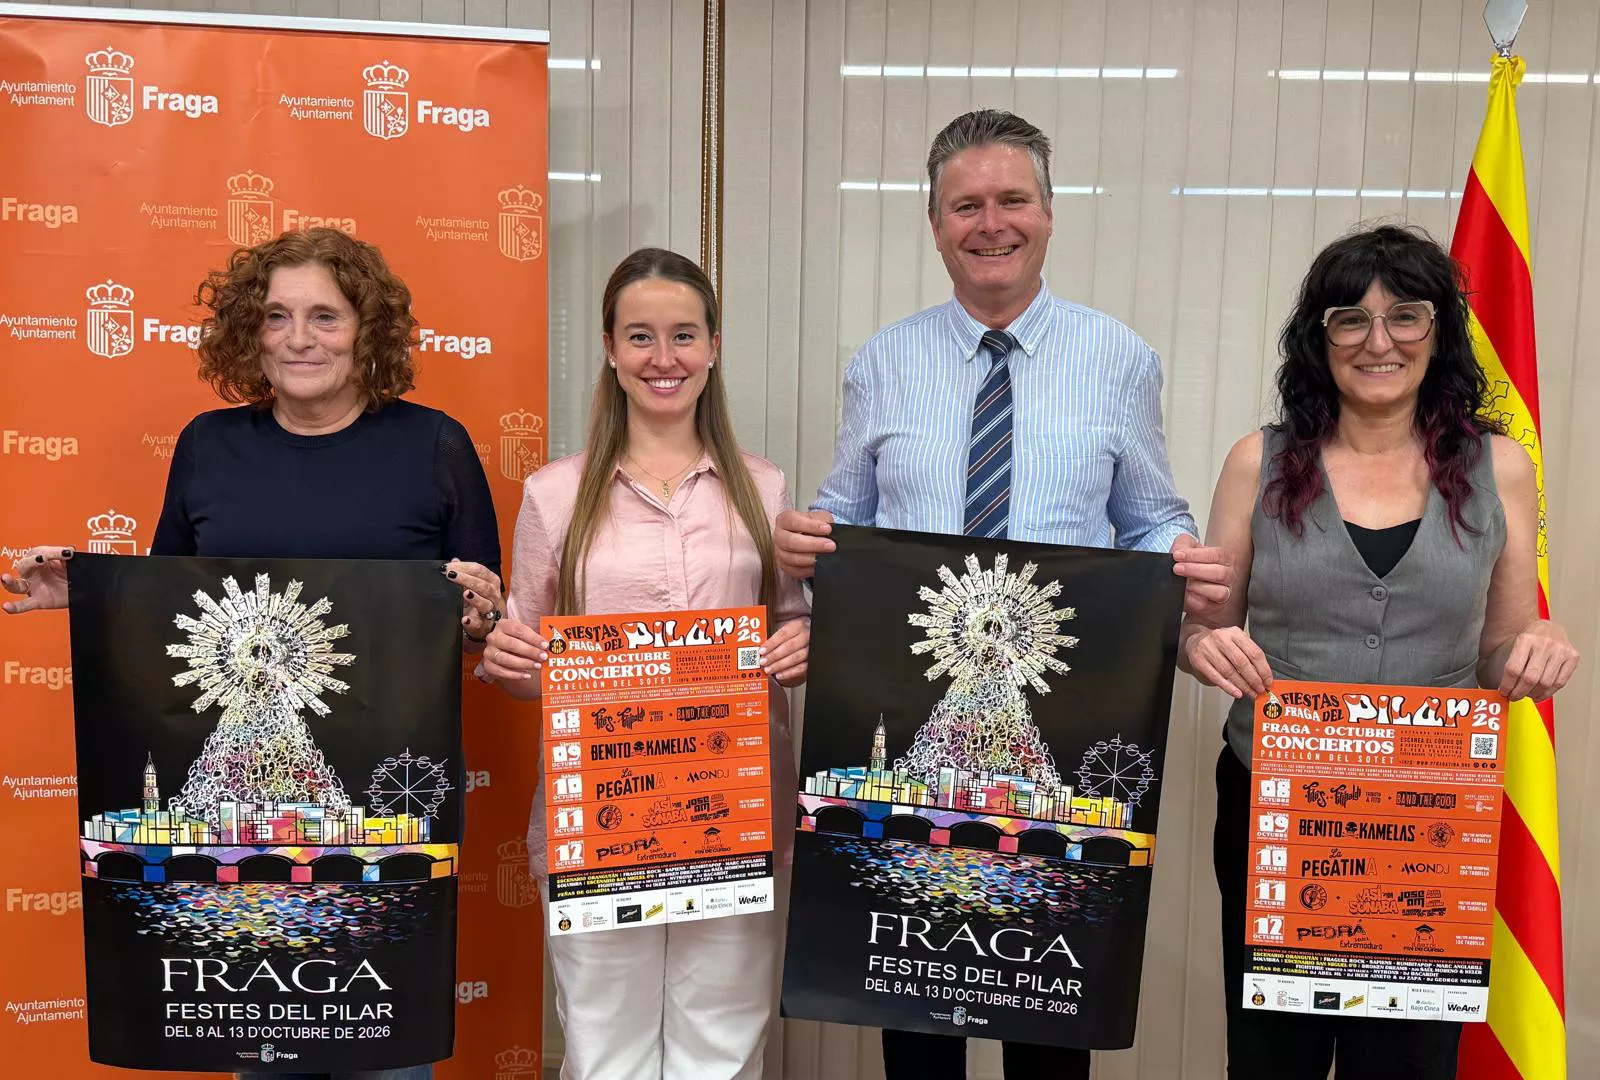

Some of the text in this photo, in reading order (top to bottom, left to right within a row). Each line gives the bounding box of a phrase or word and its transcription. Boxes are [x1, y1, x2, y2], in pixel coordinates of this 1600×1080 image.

[0, 80, 76, 94] Ayuntamiento
[11, 93, 75, 107] Ajuntament
[143, 86, 218, 119] Fraga
[280, 94, 354, 108] Ayuntamiento
[290, 108, 353, 121] Ajuntament
[418, 100, 489, 132] Fraga
[2, 197, 78, 228] Fraga
[140, 202, 218, 217] Ayuntamiento
[151, 216, 216, 230] Ajuntament
[416, 216, 490, 230] Ayuntamiento
[426, 228, 488, 242] Ajuntament
[0, 314, 77, 328] Ayuntamiento
[10, 326, 76, 340] Ajuntament
[143, 318, 203, 350] Frag
[419, 329, 492, 359] Fraga
[2, 430, 78, 461] Fraga
[564, 624, 620, 642] FIESTAS
[569, 638, 624, 652] FRAGA DEL
[548, 656, 594, 667] FRAGA
[607, 651, 670, 664] OCTUBRE
[550, 662, 672, 682] CONCIERTOS
[550, 680, 605, 691] PABELLÓN
[614, 679, 632, 688] DEL
[640, 676, 672, 686] SOTET
[1280, 692, 1340, 710] FIESTAS
[552, 712, 580, 730] 08
[1284, 706, 1344, 722] FRAGA DEL
[1262, 722, 1310, 734] FRAGA
[1324, 726, 1396, 738] OCTUBRE
[591, 742, 631, 761] BENITO
[646, 736, 696, 756] KAMELAS
[1261, 735, 1395, 754] CONCIERTOS
[552, 746, 580, 762] 09
[1260, 750, 1320, 760] PABELLÓN
[1330, 754, 1349, 762] DEL
[1358, 755, 1394, 764] SOTET
[553, 778, 582, 794] 10
[596, 772, 666, 800] PEGATINA
[1260, 780, 1290, 797] 08
[1420, 794, 1433, 806] THE
[1436, 794, 1456, 808] COOL
[554, 810, 584, 828] 11
[1259, 815, 1288, 832] 09
[1298, 819, 1342, 838] BENITO
[1360, 822, 1416, 842] KAMELAS
[555, 844, 584, 862] 12
[1256, 850, 1287, 866] 10
[1329, 848, 1342, 859] La
[1302, 858, 1378, 877] PEGATINA
[1255, 882, 1286, 900] 11
[6, 888, 82, 916] Fraga
[738, 894, 768, 905] WeAre!
[1254, 918, 1283, 936] 12
[868, 912, 1084, 969] FRAGA
[160, 958, 392, 993] FRAGA
[868, 955, 1082, 997] FESTES DEL PILAR
[865, 978, 1078, 1015] DEL 8 AL 13 D'OCTUBRE DE 2026
[5, 998, 84, 1014] Ayuntamiento
[166, 1003, 393, 1020] FESTES DEL PILAR
[1448, 1004, 1480, 1012] WeAre!
[17, 1010, 84, 1024] Ajuntament
[968, 1016, 988, 1024] Fraga
[165, 1026, 390, 1039] DEL 8 AL 13 D'OCTUBRE DE 2026
[276, 1052, 298, 1060] Fraga
